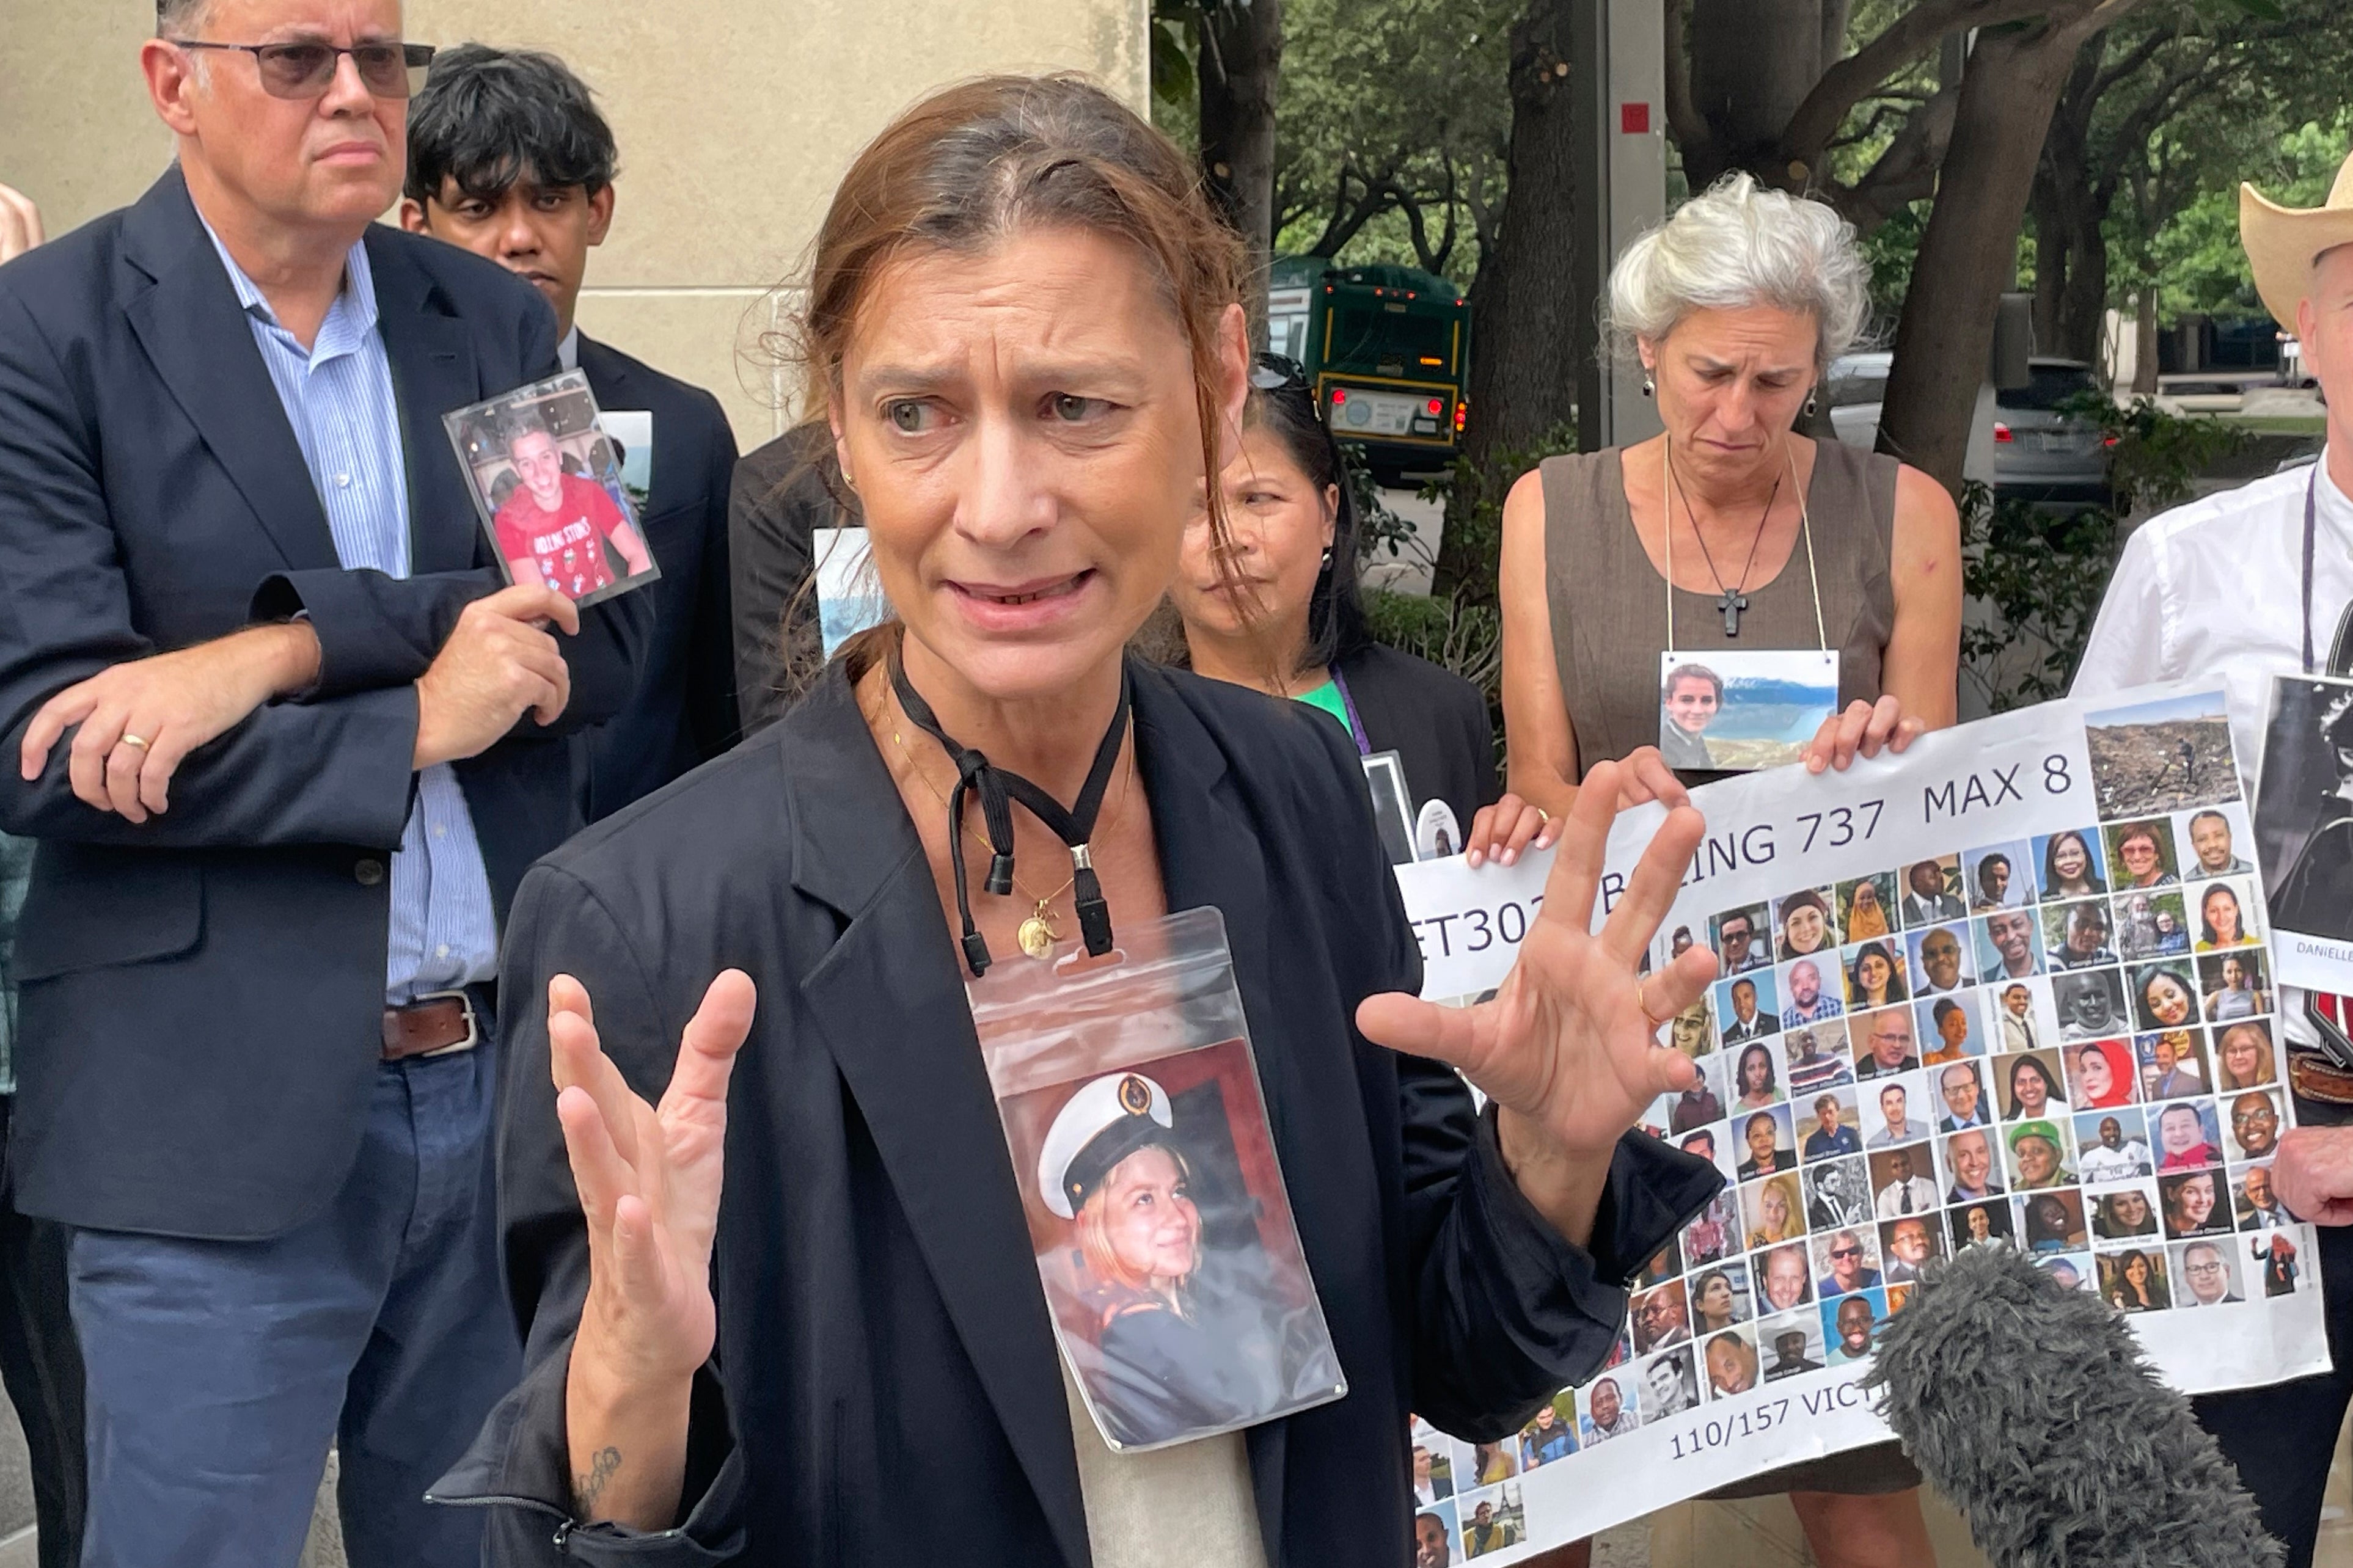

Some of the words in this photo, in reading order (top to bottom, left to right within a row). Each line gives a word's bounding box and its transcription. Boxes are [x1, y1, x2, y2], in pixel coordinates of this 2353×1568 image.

[1410, 894, 1544, 960] T30
[1601, 824, 1775, 915] BING
[1796, 798, 1884, 854] 737
[1924, 762, 2023, 823] MAX
[2043, 753, 2072, 794] 8
[1670, 1398, 1789, 1460] 110/157
